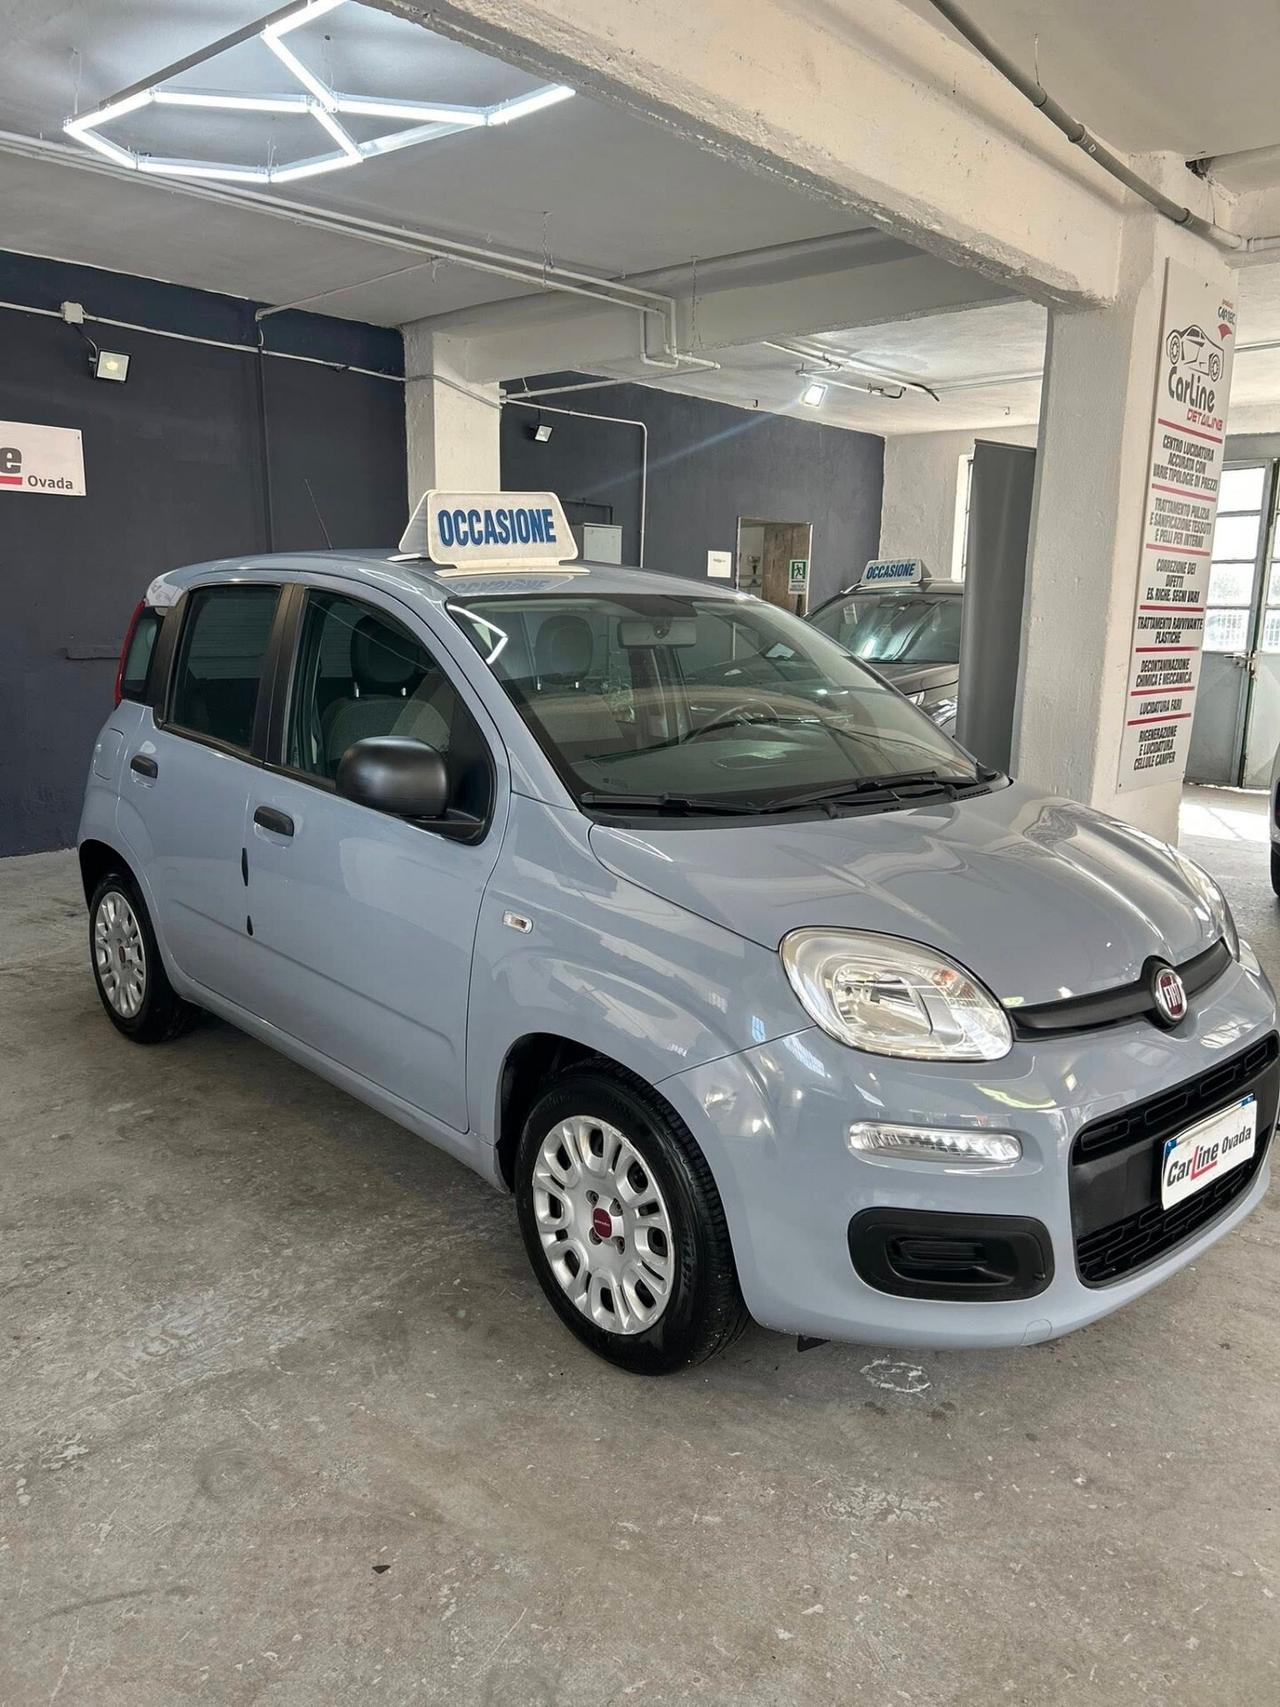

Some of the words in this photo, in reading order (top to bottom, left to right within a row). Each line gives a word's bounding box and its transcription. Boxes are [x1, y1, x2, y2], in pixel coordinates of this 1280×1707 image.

[1168, 366, 1215, 413] CarLine
[1163, 435, 1183, 453] CENTRO
[1183, 441, 1214, 462] LUCIDATURA
[1168, 452, 1195, 472] ACCURATA
[1195, 459, 1206, 475] CON
[27, 475, 73, 490] Ovada
[1153, 463, 1169, 480] VARIE
[1168, 468, 1194, 486] TIPOLOGIE
[1194, 474, 1201, 488] DI
[1201, 475, 1218, 491] PREZZI
[1155, 497, 1191, 518] TRATTAMENTO
[1191, 505, 1210, 521] PULIZIA
[438, 509, 557, 547] OCCASIONE
[1149, 512, 1154, 526] E
[1154, 512, 1192, 532] SANIFICAZIONE
[1191, 519, 1212, 535] TESSUTI
[1155, 528, 1160, 542] E
[1159, 529, 1174, 544] PELLI
[1173, 531, 1184, 545] PER
[866, 563, 916, 580] OCCASIONE
[1187, 561, 1197, 575] DEI
[1165, 574, 1184, 588] DIFETTI
[1187, 590, 1200, 603] VARI
[1137, 615, 1172, 630] TRATTAMENTO
[1171, 617, 1204, 630] RAVVIVANTE
[1155, 631, 1181, 644] PLASTICHE
[1141, 658, 1190, 673] DECONTAMINAZIONE
[1136, 673, 1159, 687] CHIMICA
[1158, 672, 1163, 686] E
[1162, 671, 1192, 685] MECCANICA
[1139, 700, 1170, 715] LUCIDATURA
[1170, 698, 1182, 711] FARI
[1139, 725, 1178, 742] RIGENERAZIONE
[1138, 743, 1144, 756] E
[1143, 738, 1174, 755] LUCIDATURA
[1133, 755, 1155, 770] CELLULE
[1154, 751, 1176, 767] CAMPER
[1167, 1143, 1219, 1187] CarLine
[1222, 1126, 1252, 1154] Ovada
